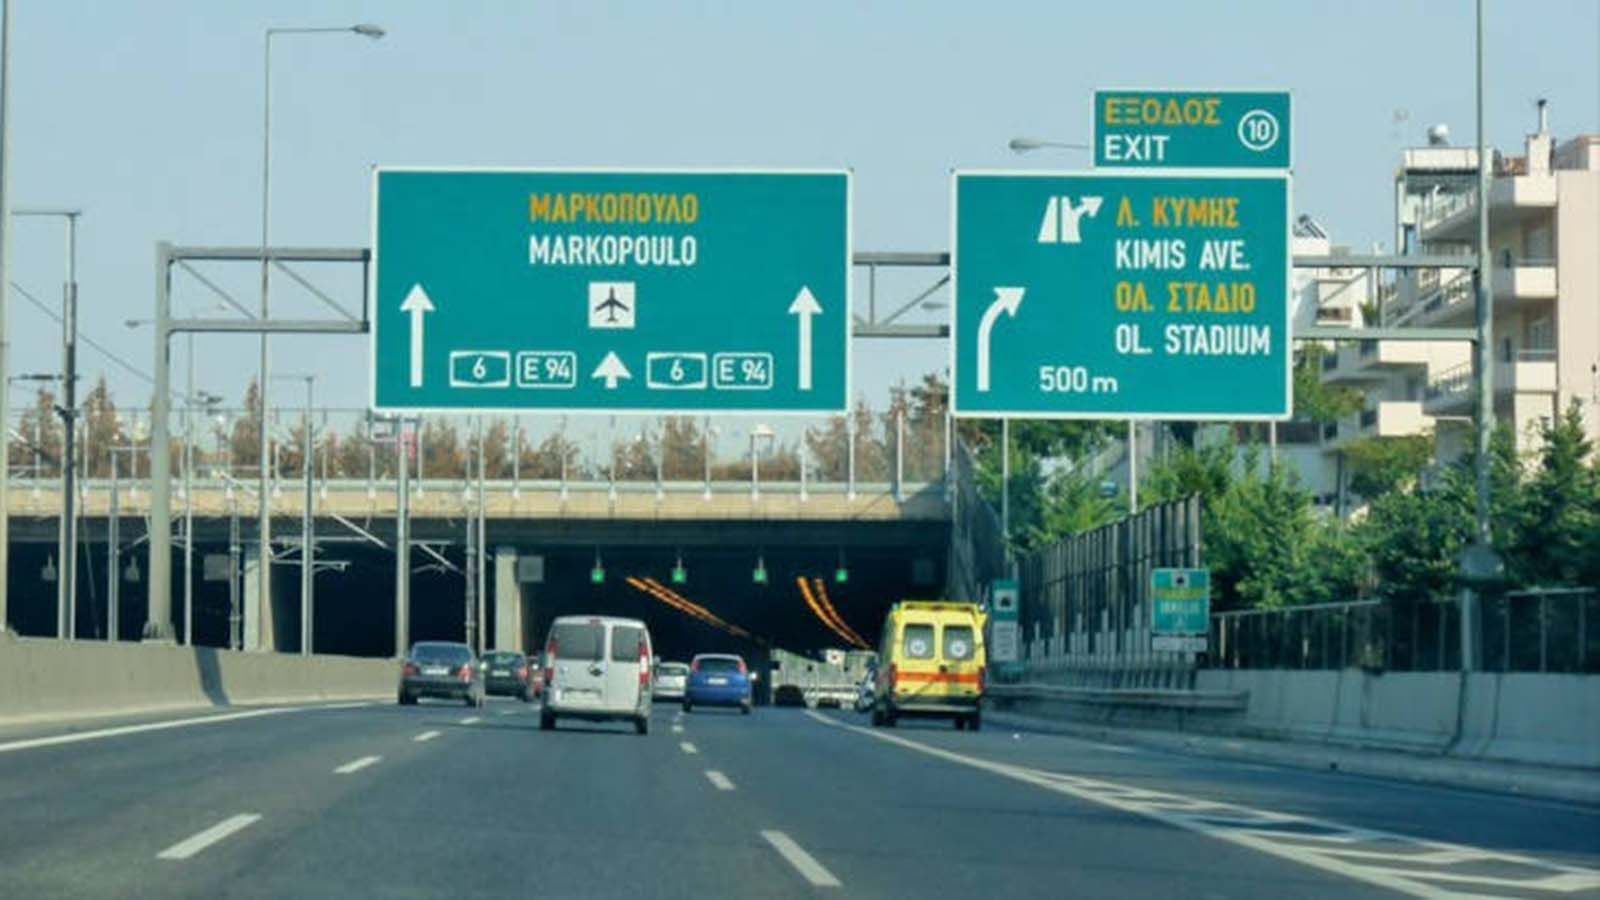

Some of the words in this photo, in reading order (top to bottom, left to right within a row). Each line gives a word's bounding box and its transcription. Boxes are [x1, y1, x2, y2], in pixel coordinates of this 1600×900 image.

[1104, 97, 1221, 125] ΕΞΟΔΟΣ
[1248, 119, 1270, 142] 10
[1104, 134, 1170, 161] EXIT
[529, 193, 698, 224] ΜΑΡΚΟΠΟΥΛΟ
[1153, 197, 1239, 228] ΚΥΜΗΣ
[529, 235, 697, 266] MARKOPOULO
[1115, 239, 1186, 270] KIMIS
[1199, 239, 1251, 270] AVE.
[1167, 282, 1256, 314] ΣΤΑΔΙΟ
[1115, 323, 1153, 355] OL.
[1165, 324, 1271, 355] STADIUM
[472, 357, 486, 380] 6
[523, 357, 539, 380] E
[545, 356, 571, 380] 94
[670, 357, 684, 381] 6
[718, 357, 735, 382] E
[742, 357, 768, 382] 94
[1040, 366, 1088, 393] 500
